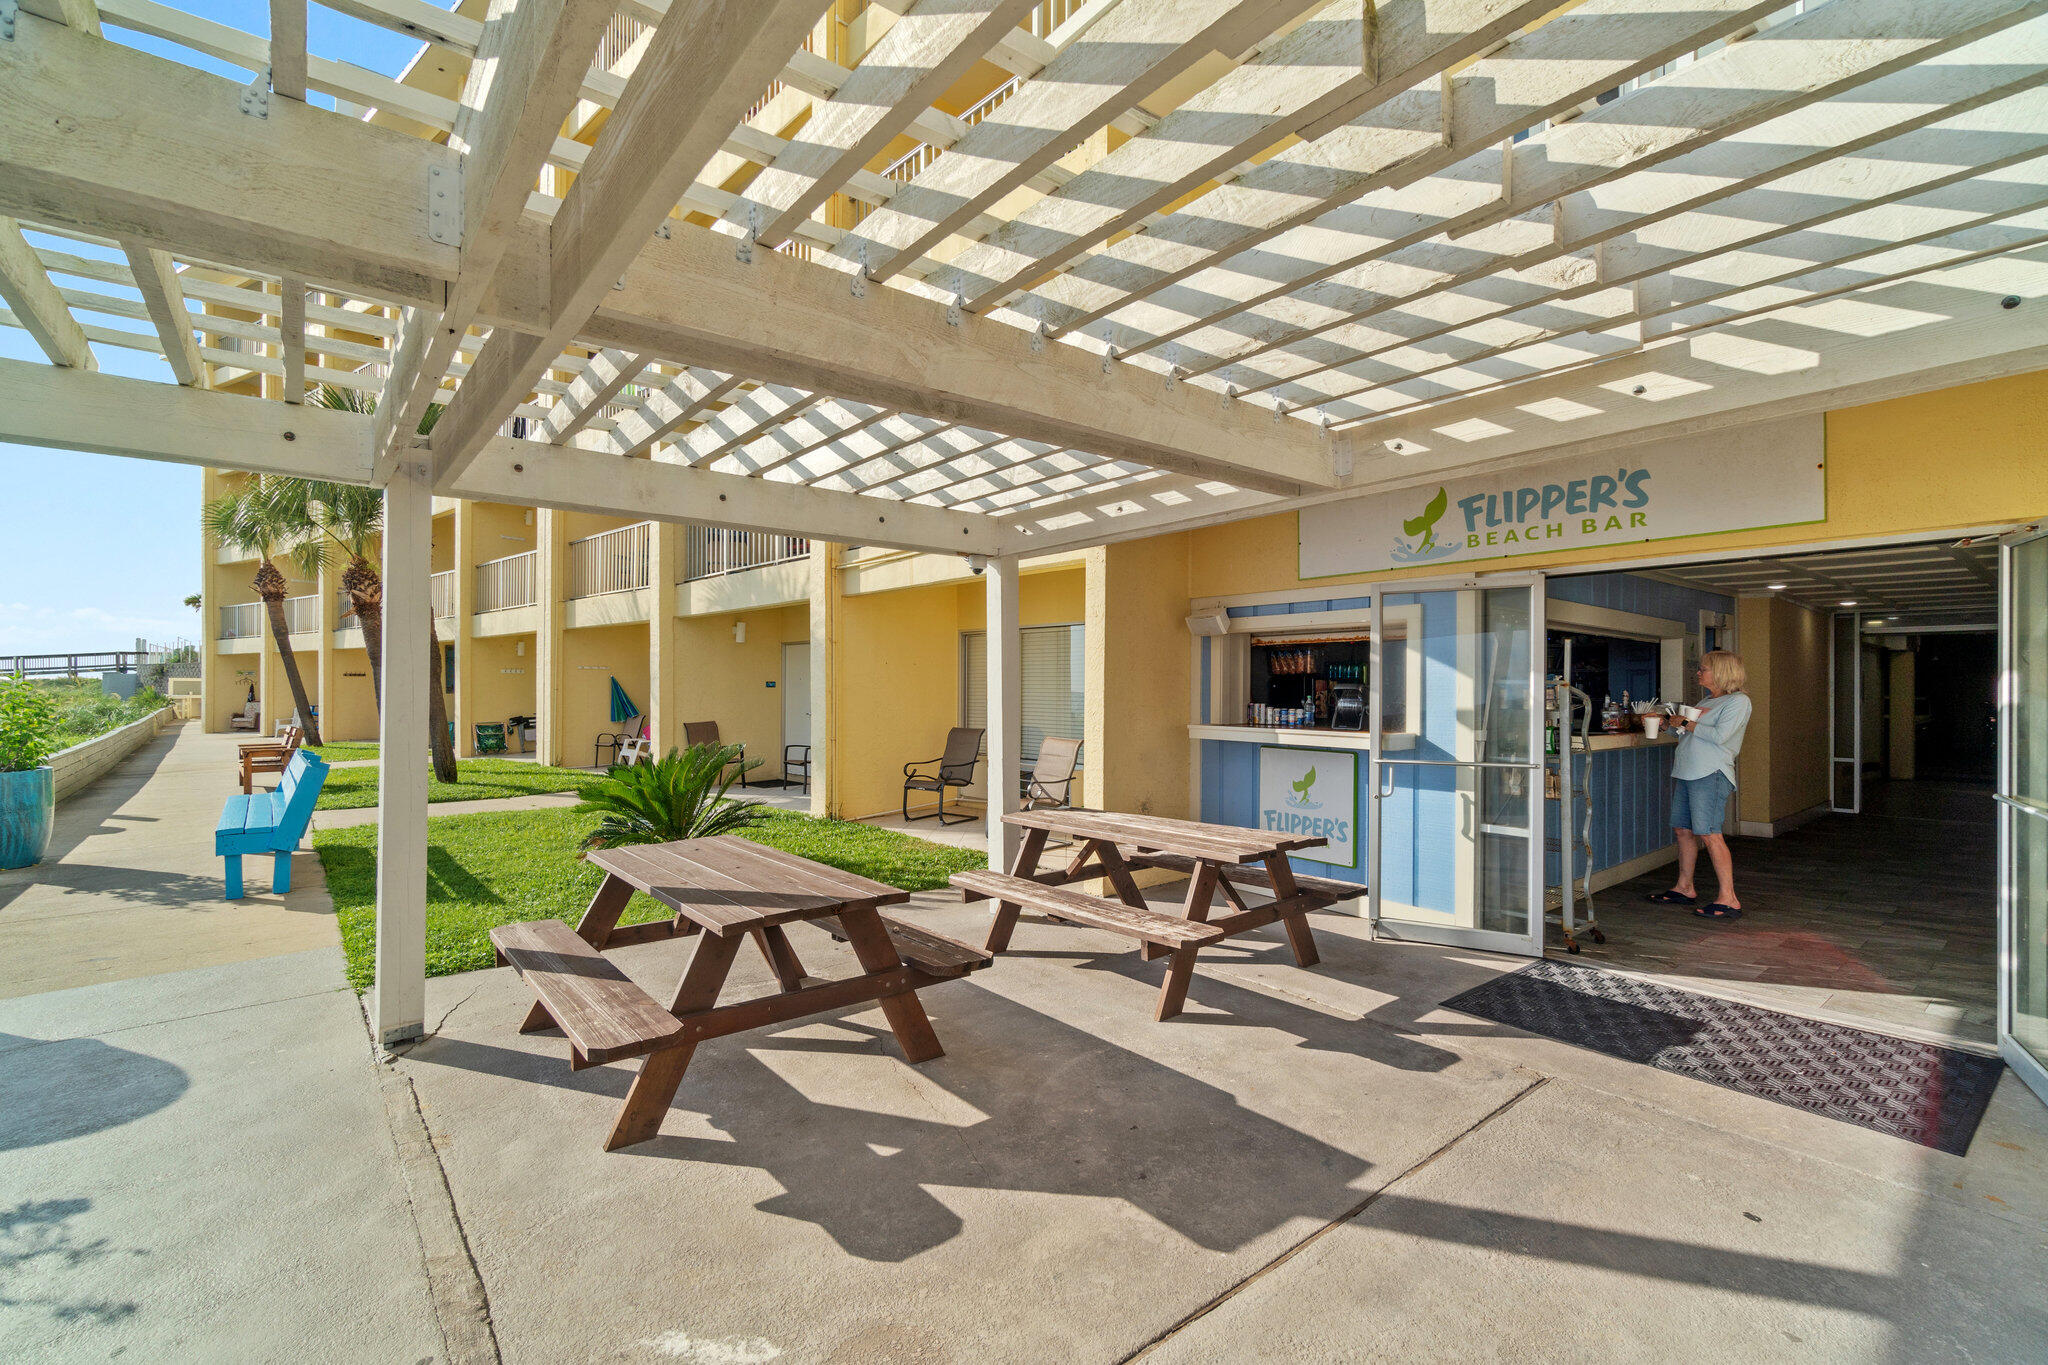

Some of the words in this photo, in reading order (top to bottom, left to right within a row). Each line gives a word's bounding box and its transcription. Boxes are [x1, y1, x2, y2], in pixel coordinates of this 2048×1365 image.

[1457, 468, 1651, 532] FLIPPER'S
[1467, 522, 1563, 548] BEACH
[1581, 512, 1648, 535] BAR
[1263, 809, 1349, 843] FLIPPER'S
